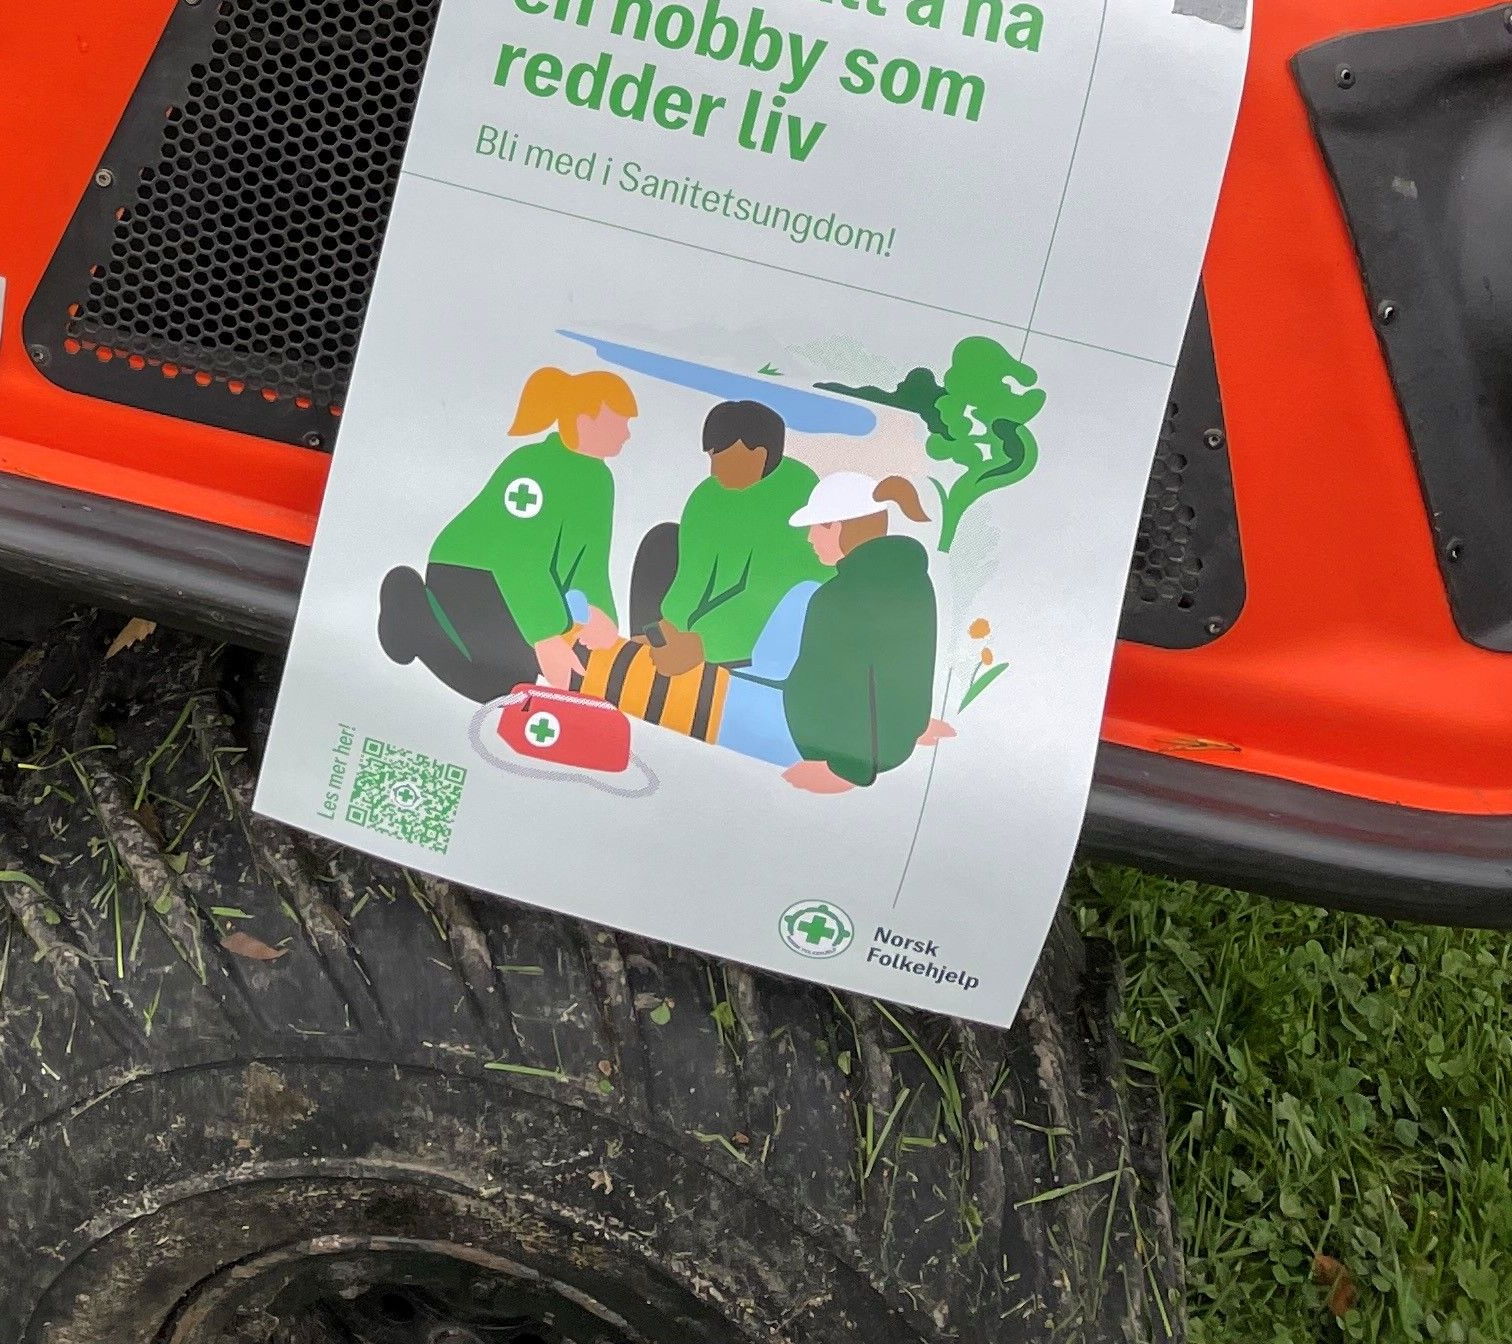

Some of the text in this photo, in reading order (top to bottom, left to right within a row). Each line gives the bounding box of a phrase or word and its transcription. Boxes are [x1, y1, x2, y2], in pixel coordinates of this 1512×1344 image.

[493, 42, 827, 162] redder liv
[839, 47, 987, 122] som
[475, 125, 896, 258] Bli med i Sanitetsungdom!
[316, 723, 356, 820] Les mer her!
[867, 947, 980, 991] Folkehjelp
[873, 926, 940, 958] Norsk
